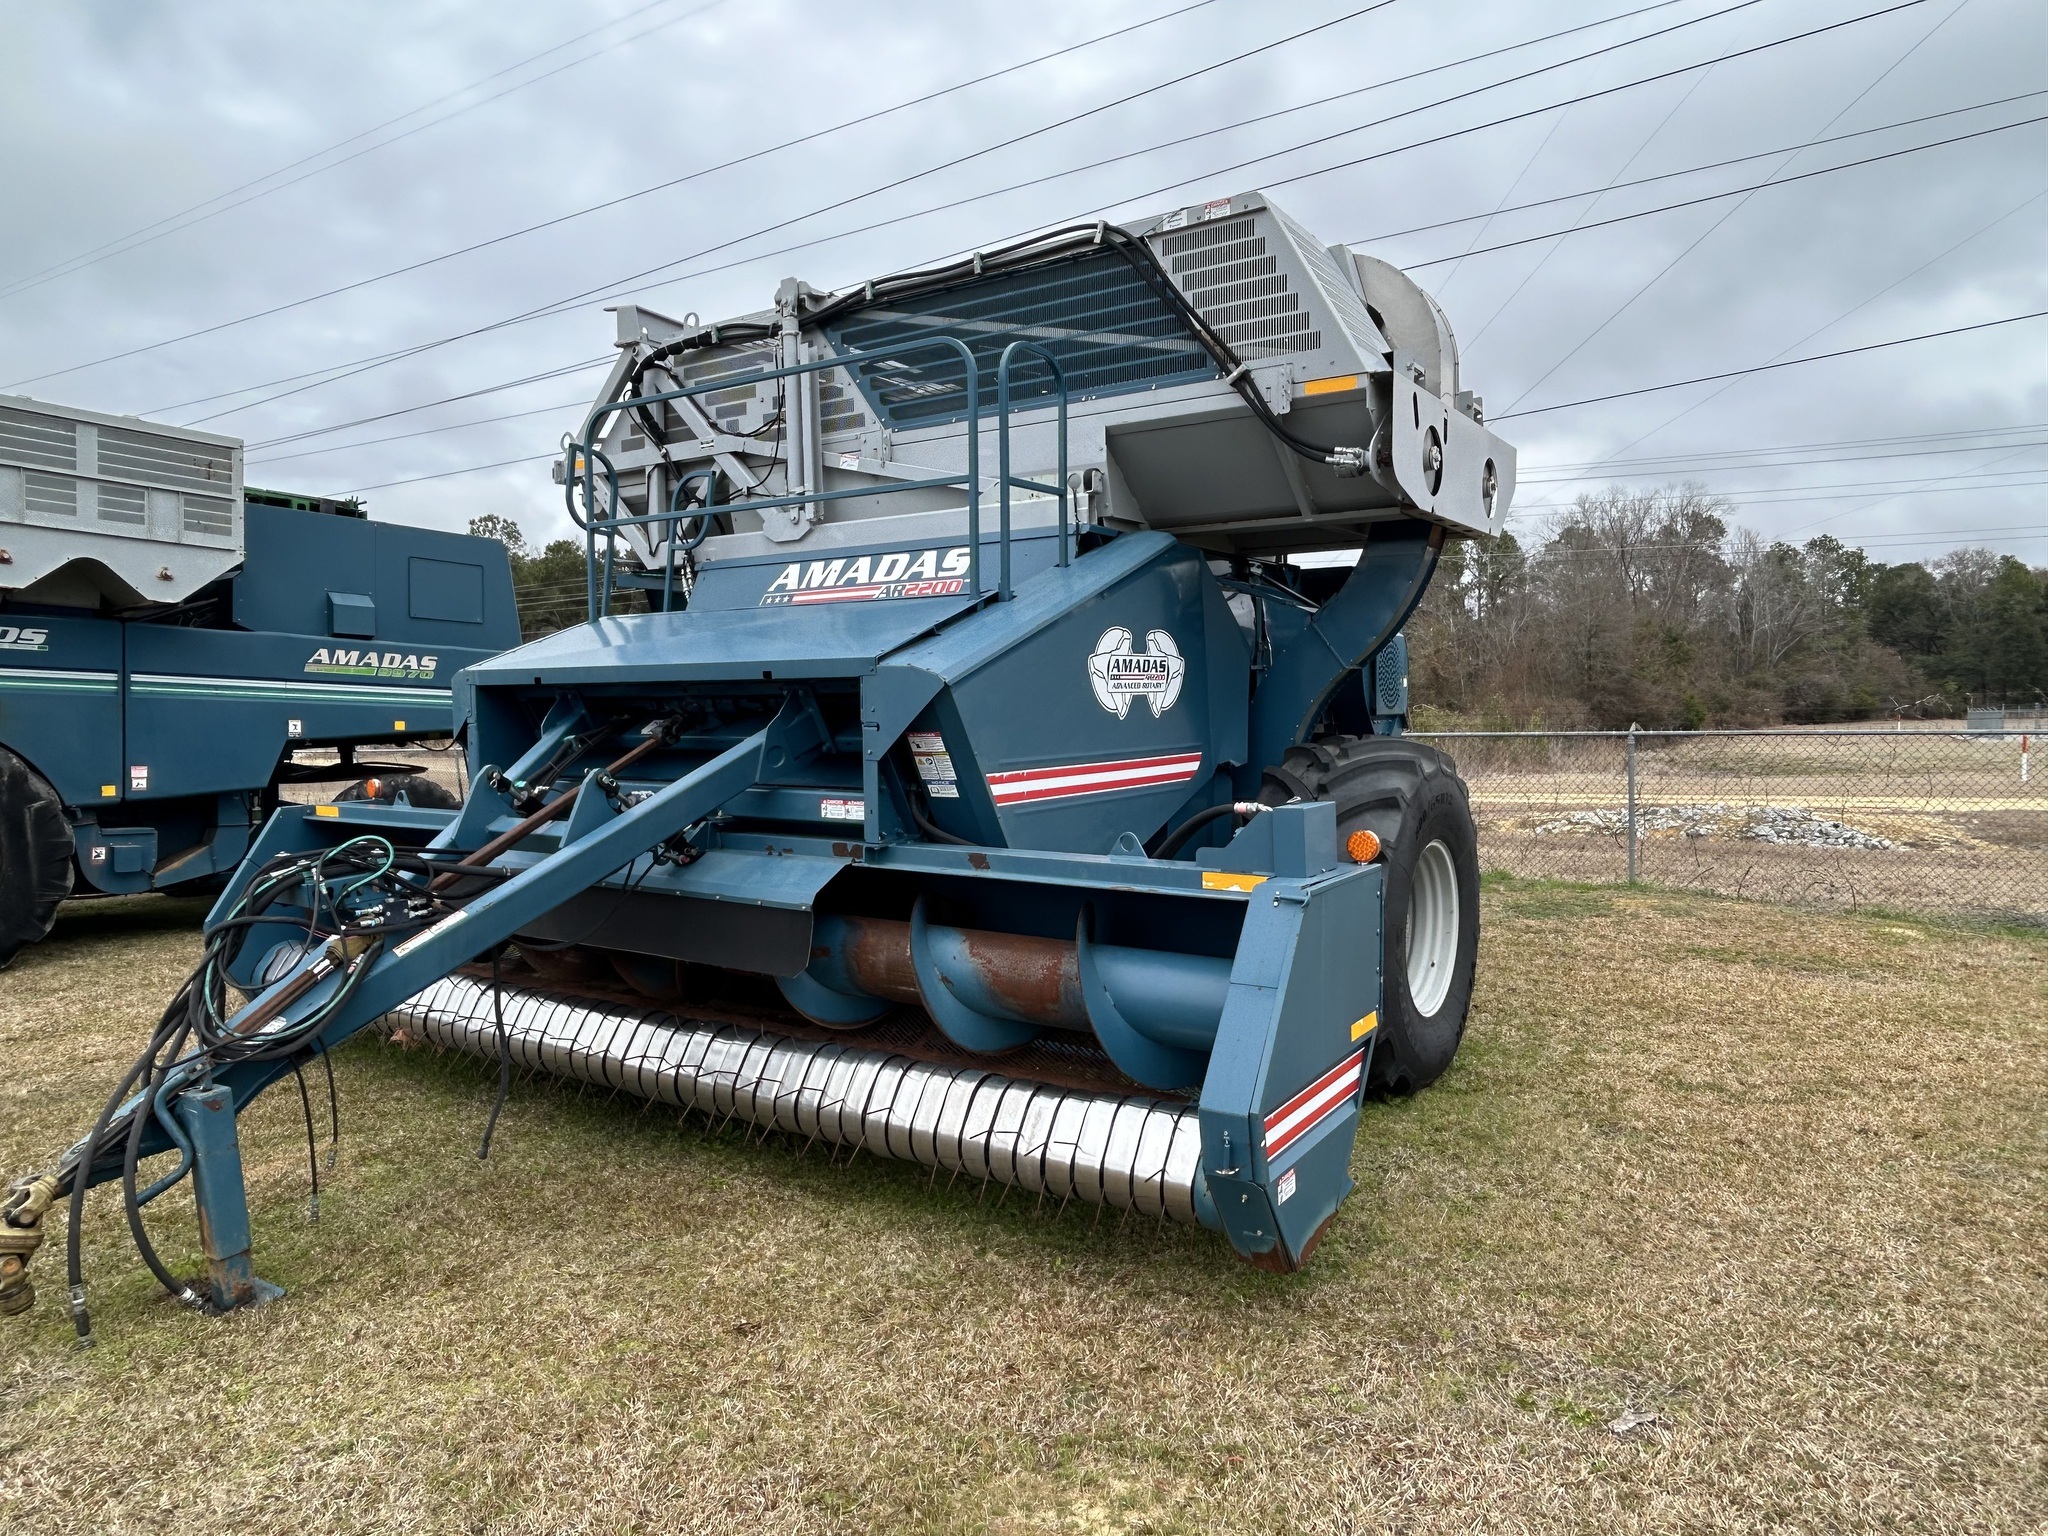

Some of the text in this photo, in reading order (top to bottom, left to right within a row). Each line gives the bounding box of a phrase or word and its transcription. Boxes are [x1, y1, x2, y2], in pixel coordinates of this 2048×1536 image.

[767, 547, 970, 592] AMADAS
[876, 578, 963, 599] AR2200
[307, 648, 438, 671] AMADAS
[1110, 658, 1167, 673] AMADAS
[1111, 682, 1141, 690] ADVANCED
